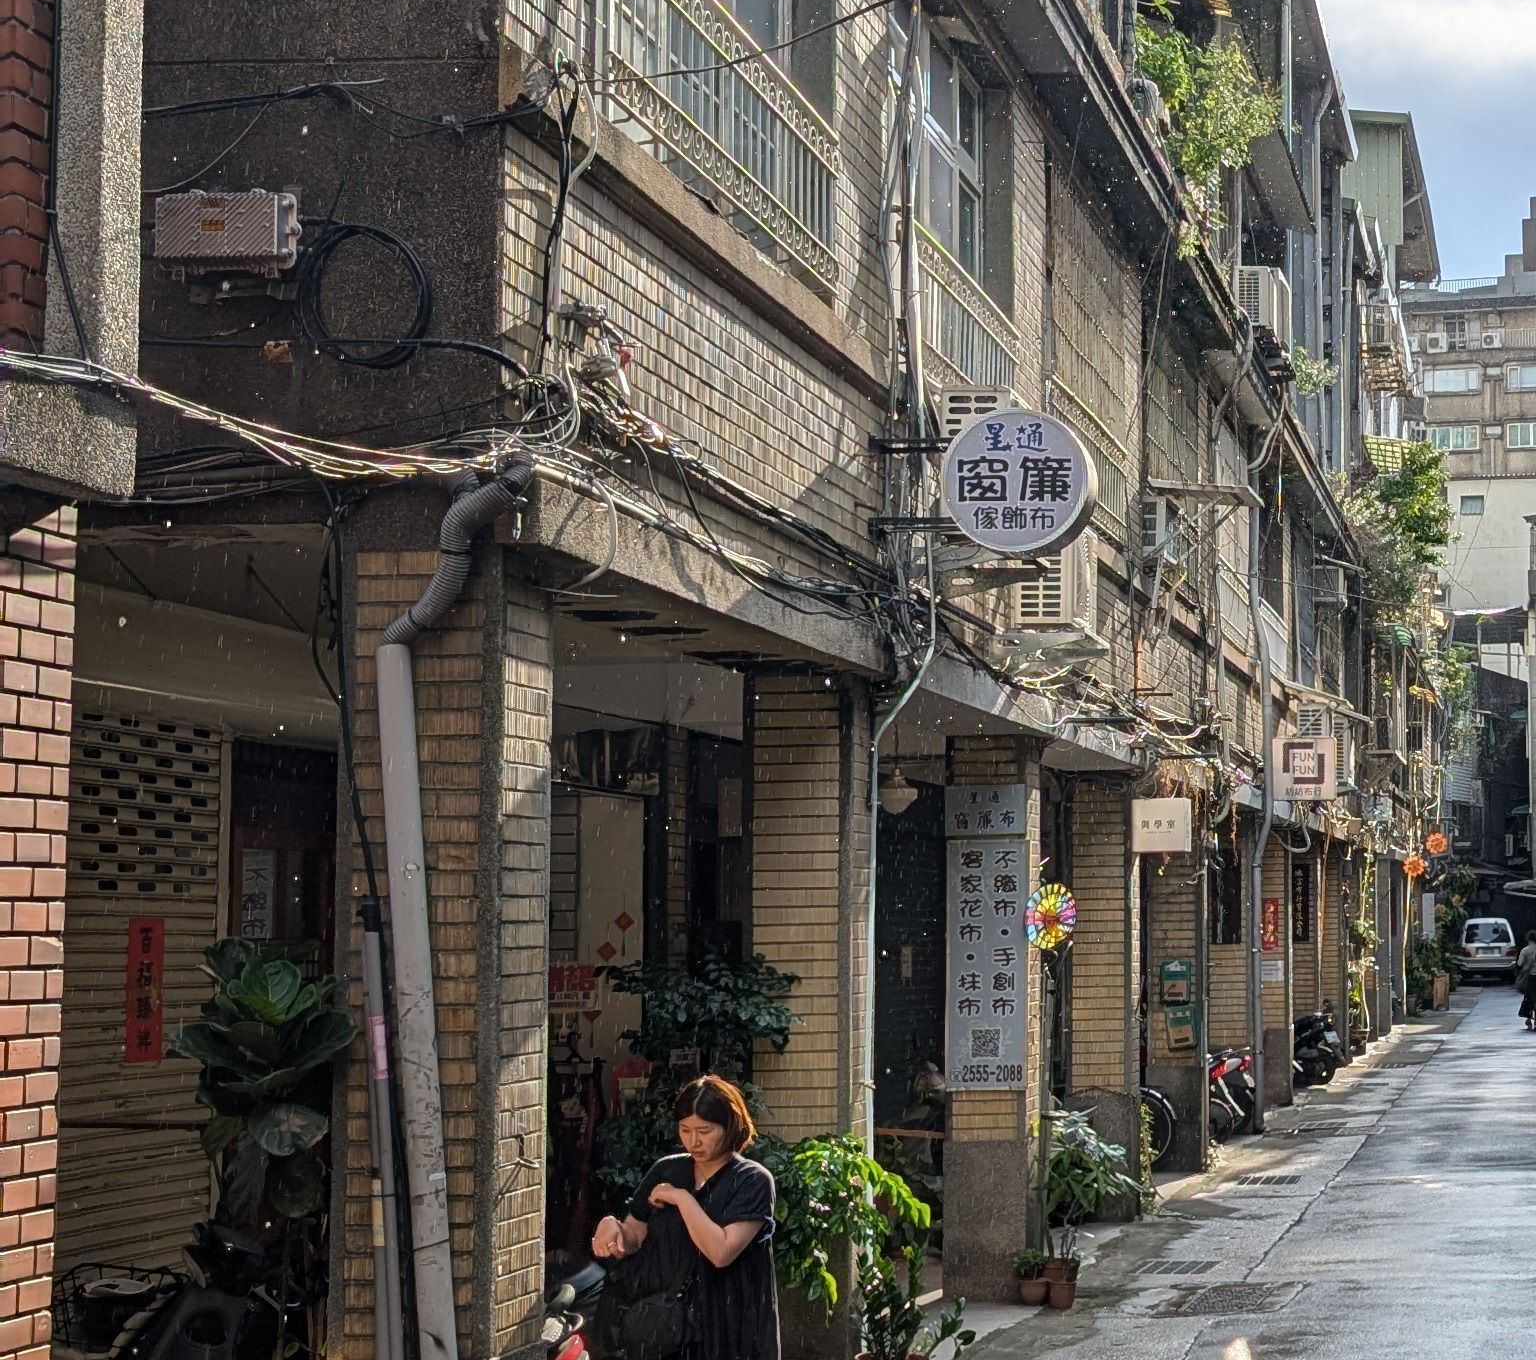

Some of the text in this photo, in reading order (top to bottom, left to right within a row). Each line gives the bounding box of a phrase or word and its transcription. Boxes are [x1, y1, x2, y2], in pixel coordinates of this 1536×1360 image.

[985, 422, 1049, 452] 星通
[957, 456, 1072, 502] 窗簾
[973, 506, 1056, 531] 傢飾布
[1293, 752, 1315, 762] FUN
[1293, 765, 1315, 775] FUN
[962, 1064, 1023, 1083] 2555-2088
